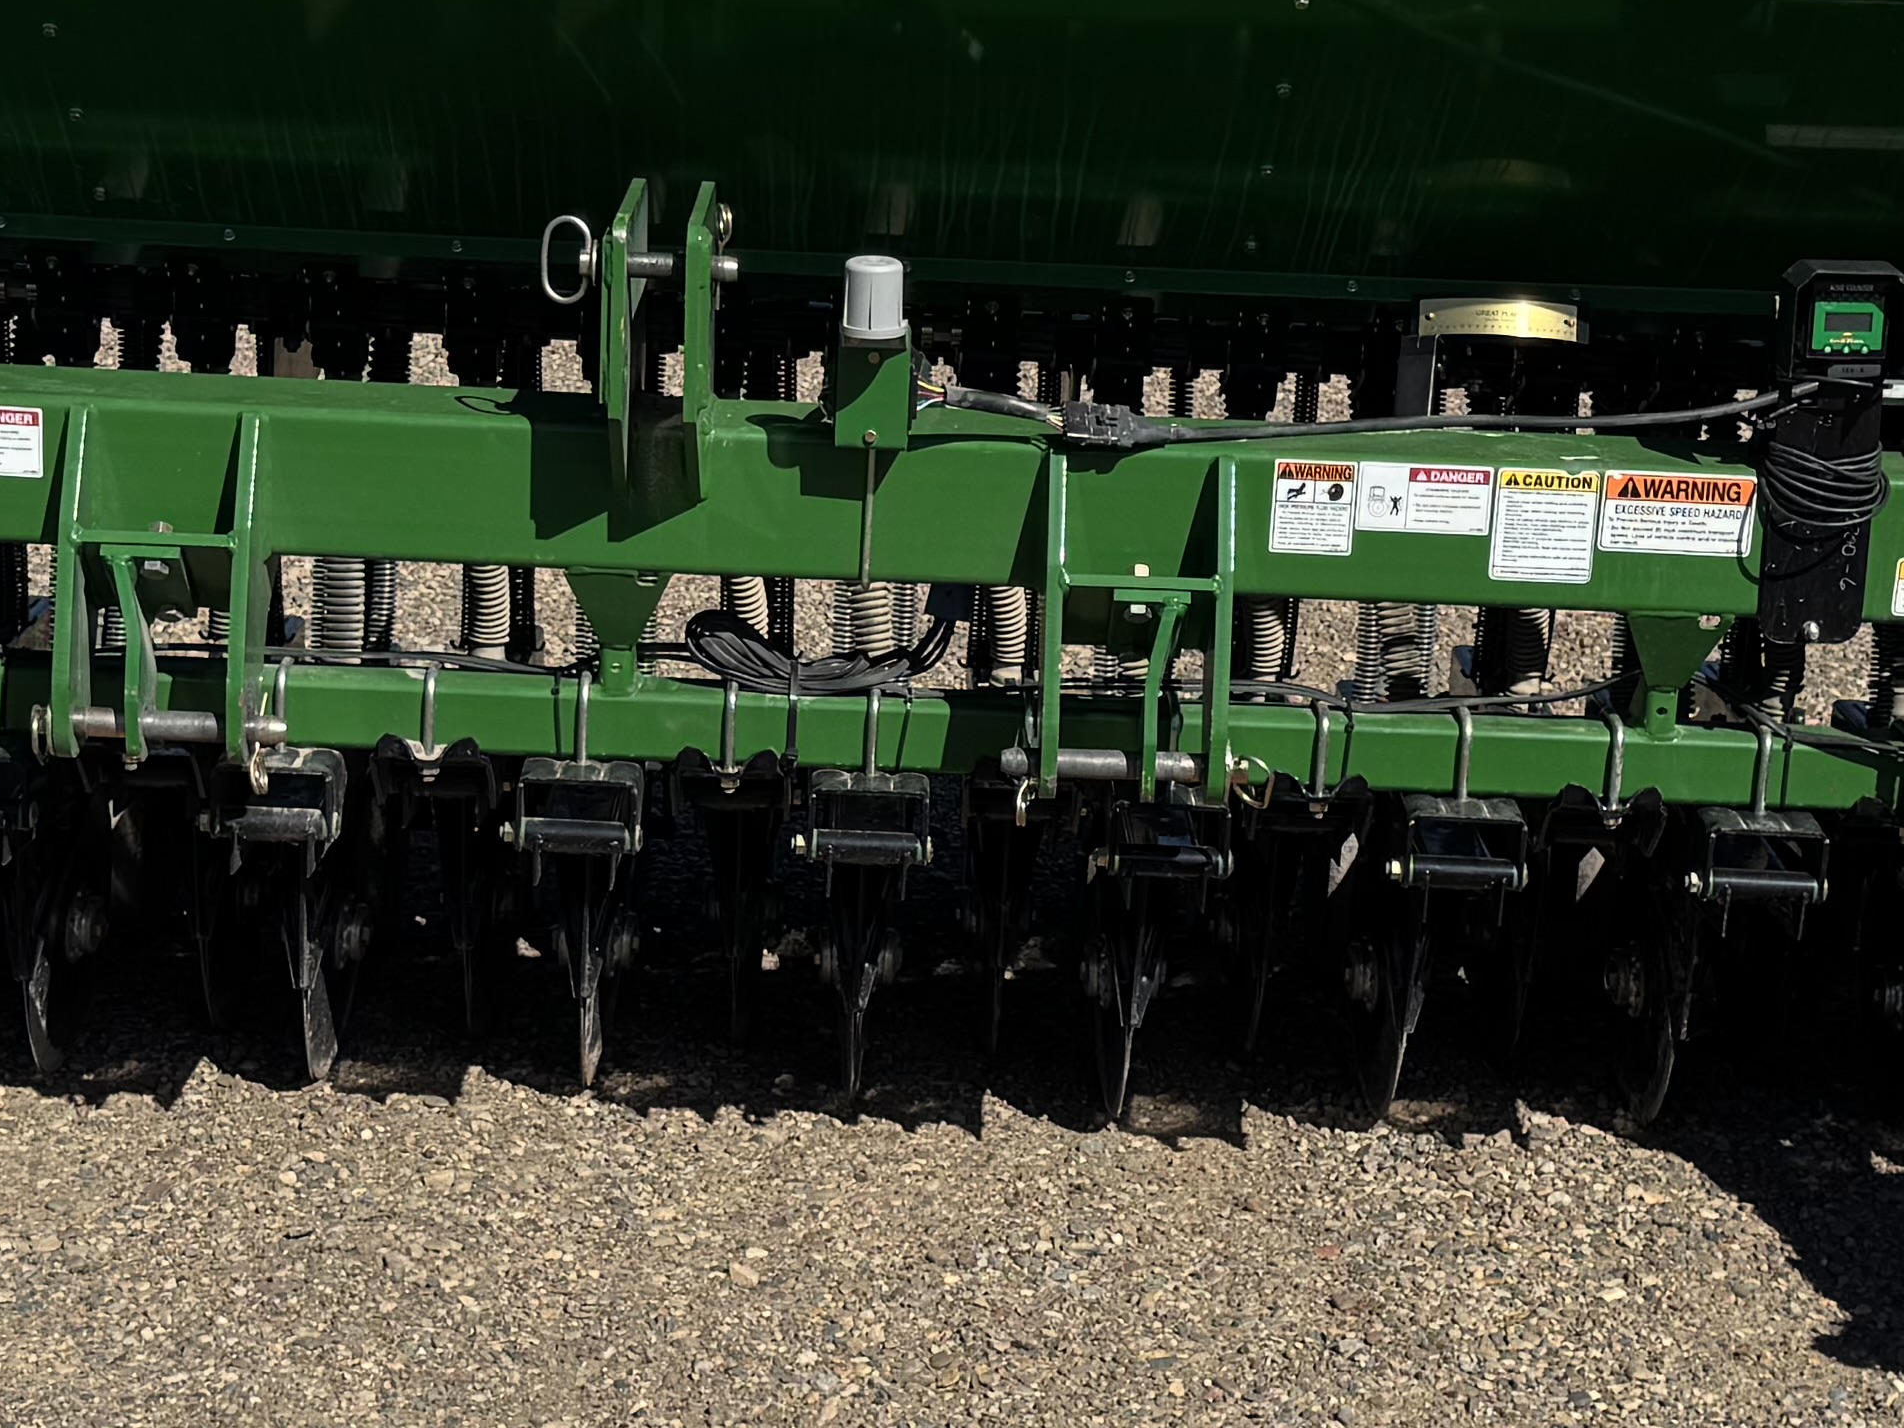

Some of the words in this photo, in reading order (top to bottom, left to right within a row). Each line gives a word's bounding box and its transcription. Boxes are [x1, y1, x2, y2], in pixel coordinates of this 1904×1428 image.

[1294, 464, 1352, 480] WARNING
[1430, 470, 1485, 484] DANGER
[1522, 474, 1593, 490] CAUTION
[1643, 479, 1742, 503] WARNING
[1615, 504, 1666, 516] EXCESSIVE
[1669, 507, 1700, 518] SPEED
[1703, 508, 1742, 520] HAZARD
